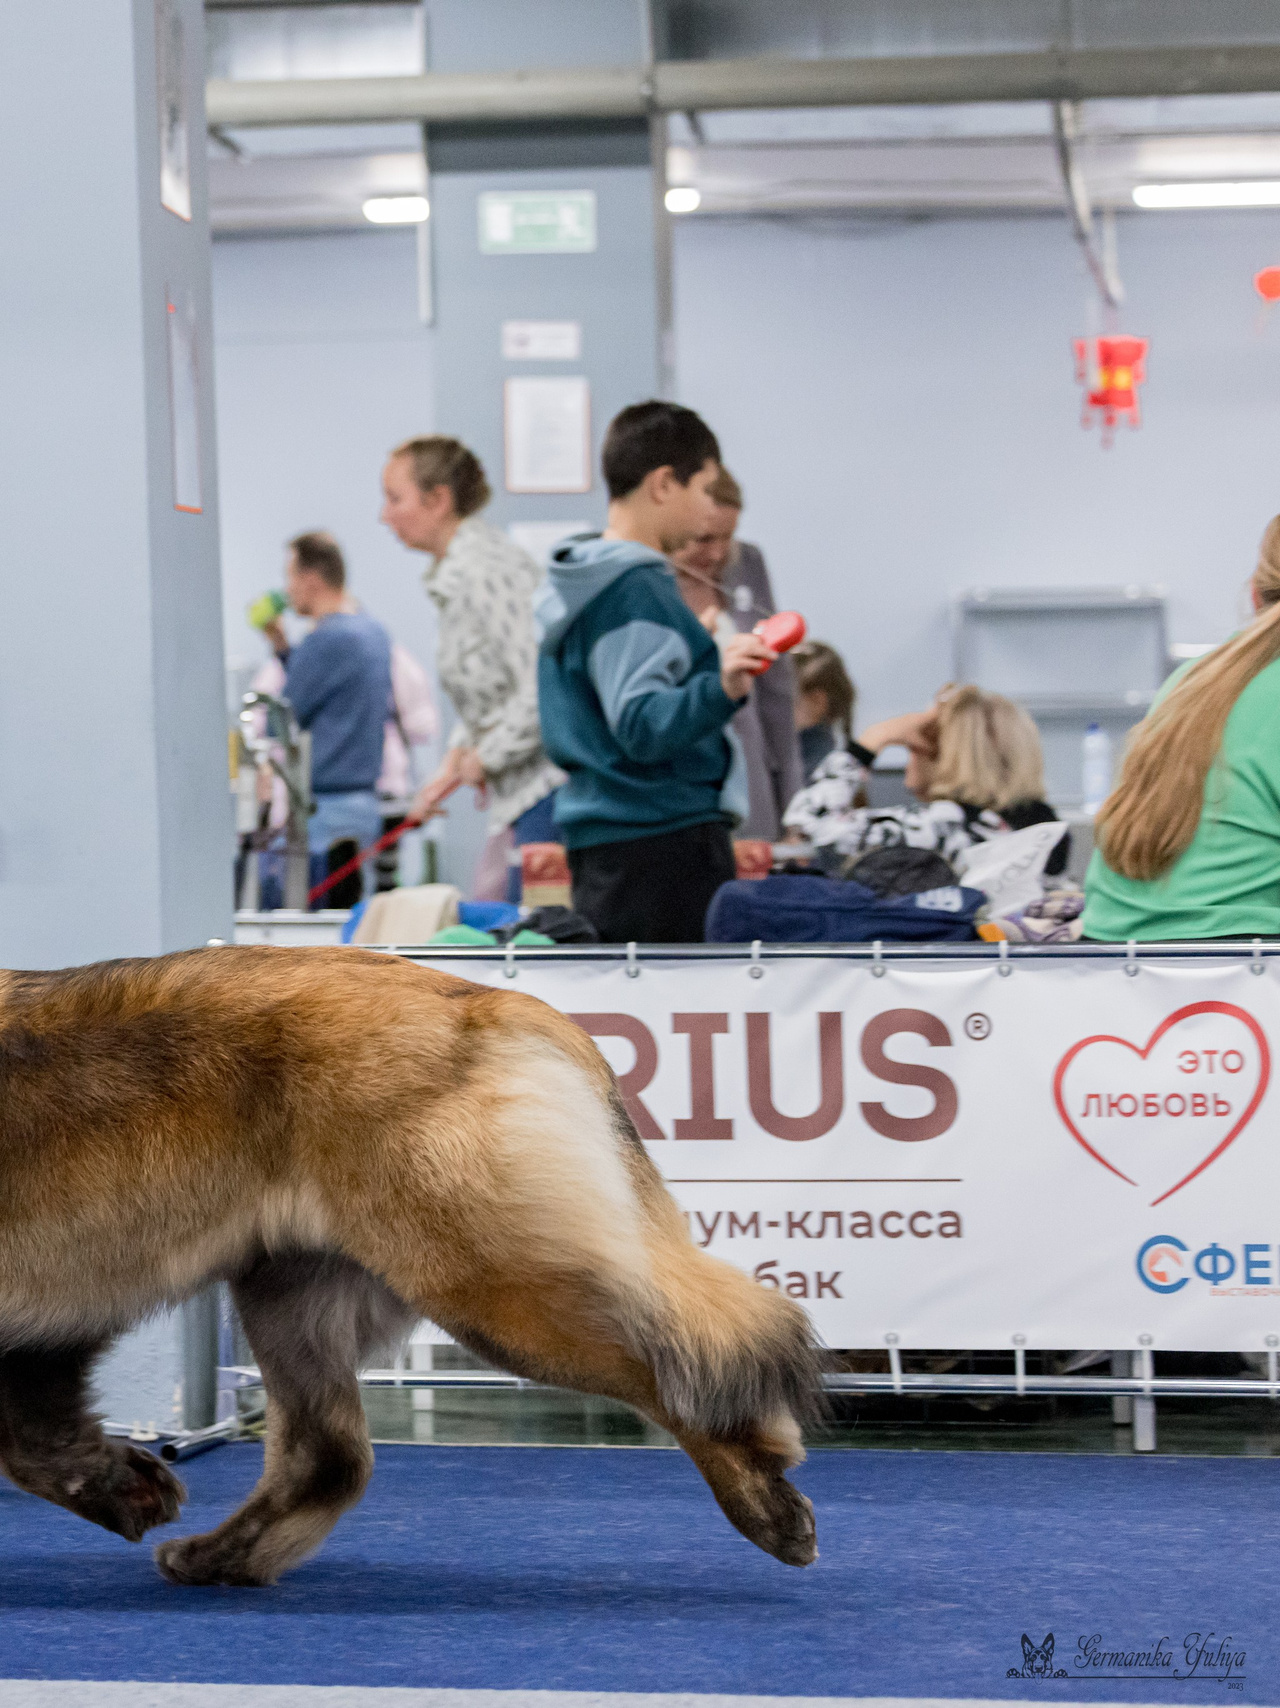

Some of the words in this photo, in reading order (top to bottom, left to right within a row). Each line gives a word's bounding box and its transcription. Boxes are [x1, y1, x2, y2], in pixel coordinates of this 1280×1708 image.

[1177, 1049, 1245, 1074] ЭТО
[1080, 1093, 1232, 1118] ЛЮБОВЬ
[683, 1211, 963, 1248] ум-класса
[754, 1260, 844, 1299] бак
[1136, 1234, 1280, 1294] СФЕ
